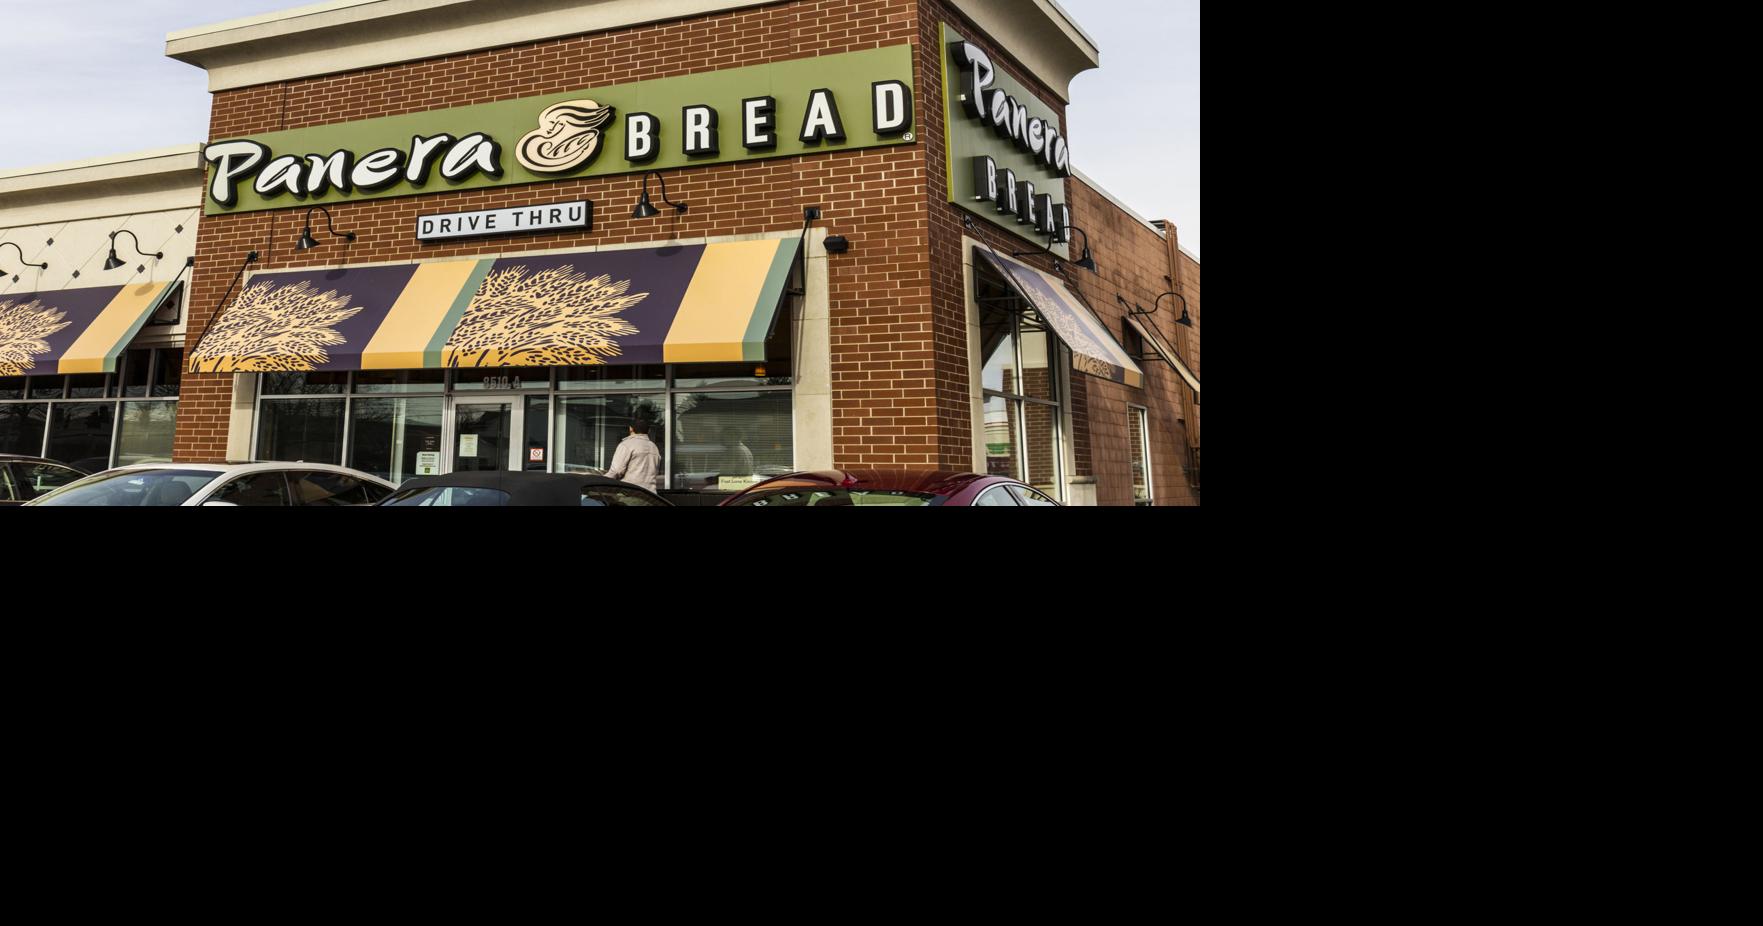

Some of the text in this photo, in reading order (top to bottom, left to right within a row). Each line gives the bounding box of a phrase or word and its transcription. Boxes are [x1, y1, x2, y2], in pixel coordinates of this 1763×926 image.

[204, 132, 503, 208] Panera
[625, 80, 912, 163] BREAD
[952, 40, 1070, 178] Panera
[422, 206, 582, 235] DRIVE THRU
[977, 155, 1070, 243] BREAD
